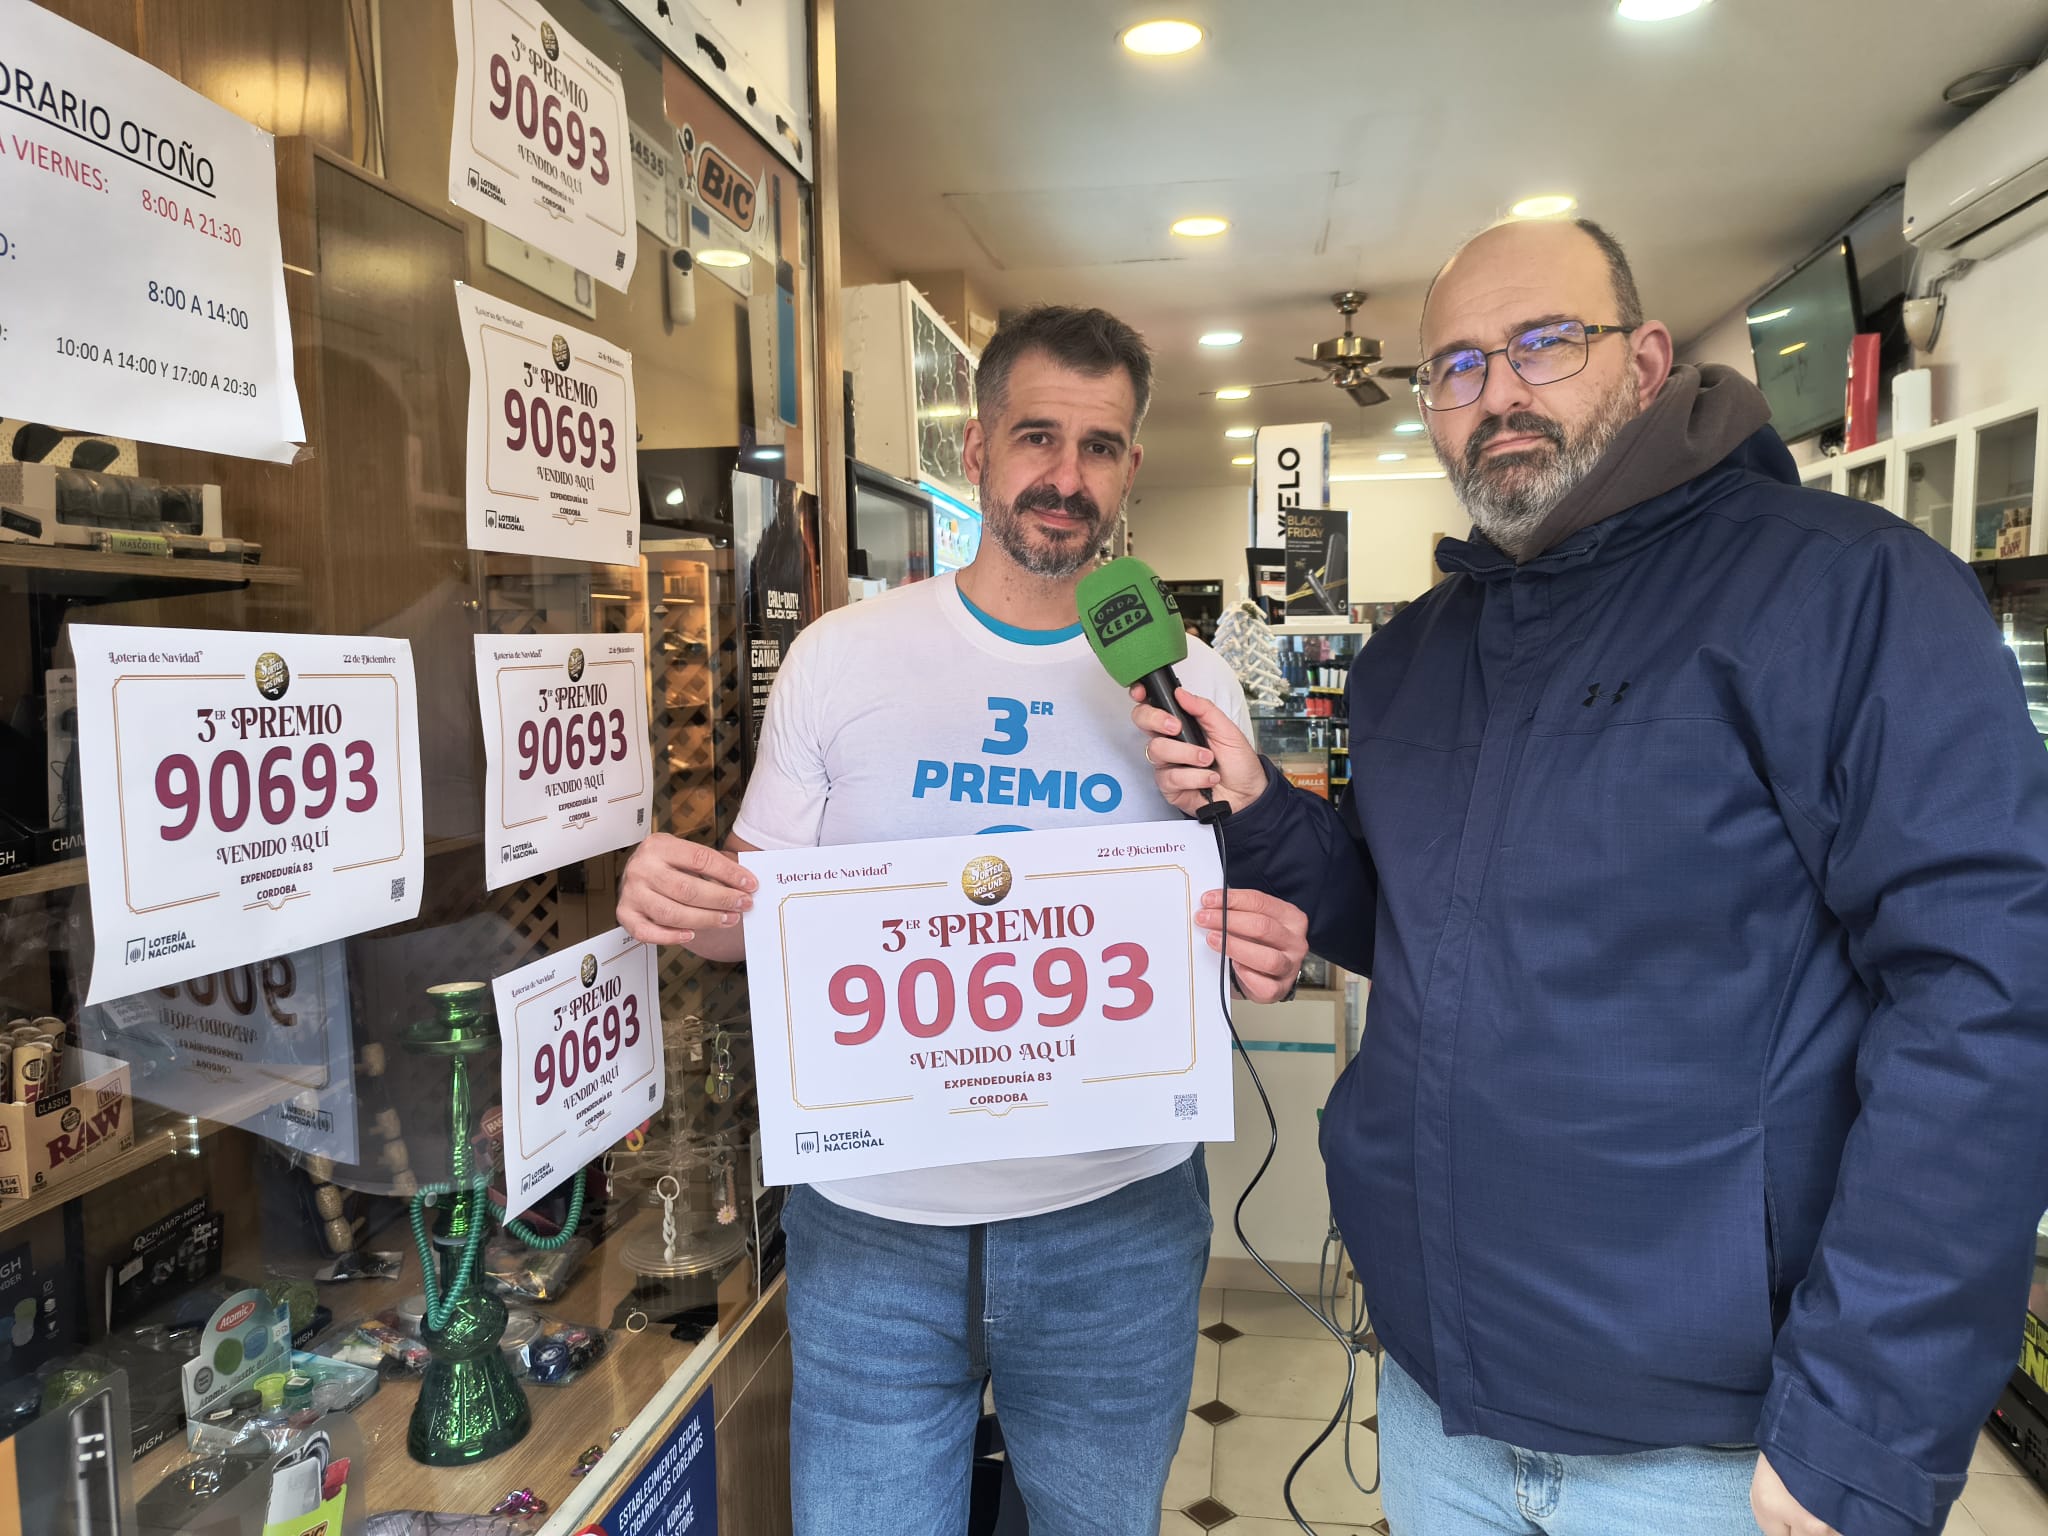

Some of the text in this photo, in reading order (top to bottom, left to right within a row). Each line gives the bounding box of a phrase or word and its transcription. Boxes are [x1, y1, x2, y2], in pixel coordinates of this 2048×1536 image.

[529, 49, 588, 113] PREMIO
[490, 54, 609, 185] 90693
[12, 135, 109, 194] VIERNES:
[120, 121, 214, 188] OTOÑO
[517, 144, 559, 181] VENDIDO
[480, 177, 501, 194] LOTERÍA
[480, 186, 507, 206] NACIONAL
[142, 189, 242, 247] 8:00 A 21:30
[148, 281, 249, 330] 8:00 A 14:00
[56, 337, 257, 398] 10:00 A 14:00 Y 17:00 A 20:30
[540, 368, 598, 409] PREMIO
[504, 388, 616, 473] 90693
[536, 466, 595, 492] VENDIDO AQUÍ
[498, 514, 520, 524] LOTERÍA
[498, 521, 525, 532] NACIONAL
[1287, 515, 1324, 527] BLACK
[1287, 527, 1326, 538] FRIDAY
[119, 541, 162, 550] MASCOTTE
[2000, 539, 2022, 559] RAW
[767, 589, 780, 609] CALL
[784, 591, 799, 610] DUTY
[1097, 597, 1136, 620] ONDA
[766, 608, 798, 620] BLACK OPS
[1106, 610, 1141, 635] CERO
[148, 652, 161, 664] de
[342, 654, 397, 665] 22 de Diciembre
[751, 649, 780, 668] GANAR
[539, 683, 607, 713] 3ER PREMIO
[197, 703, 343, 743] 3ER PREMIO
[982, 696, 1054, 756] 3ER
[518, 708, 627, 781] 90693
[155, 740, 378, 842] 90693
[544, 770, 605, 798] VENDIDO AQUÍ
[912, 759, 1122, 813] PREMIO
[1297, 778, 1325, 786] HALLS
[568, 811, 590, 823] CORDOBA
[216, 826, 330, 866] VENDIDO AQUÍ
[512, 840, 533, 853] LOTERÍA
[512, 848, 538, 861] NACIONAL
[1097, 842, 1186, 858] 22 de Diciembre
[240, 862, 313, 885] EXPENDEDURÍA 83
[824, 869, 838, 880] de
[840, 862, 893, 879] Navidad
[970, 863, 1003, 882] SORTEO
[257, 884, 298, 901] CORDOBA
[973, 877, 1003, 897] NOS UNE
[148, 930, 187, 950] LOTERÍA
[882, 904, 1095, 953] 3ER PREMIO
[148, 939, 197, 960] NACIONAL
[569, 975, 622, 1022] PREMIO
[828, 941, 1154, 1046] 90693
[534, 994, 640, 1106] 90693
[910, 1036, 1076, 1070] VENDIDO AQUÍ
[563, 1062, 620, 1111] VENDIDO AQUÍ
[944, 1071, 1053, 1089] EXPENDEDURÍA 83
[38, 1096, 69, 1114] CLASSIC
[969, 1092, 1029, 1106] CORDOBA
[584, 1109, 606, 1127] CORDOBA
[46, 1097, 125, 1169] RAW
[823, 1128, 872, 1143] LOTERÍA
[824, 1138, 885, 1153] NACIONAL
[35, 1172, 43, 1184] 6
[531, 1162, 551, 1180] LOTERÍA
[531, 1167, 554, 1187] NACIONAL
[218, 1306, 250, 1329] Atomic
[294, 1328, 314, 1348] HIGH
[132, 1432, 163, 1459] HIGH
[619, 1415, 701, 1532] ESTABLECIMIENTO OFICIAL
[629, 1432, 704, 1536] CIGARRILLOS COREANOS
[667, 1488, 691, 1533] KOREAN
[675, 1505, 695, 1536] STORE
